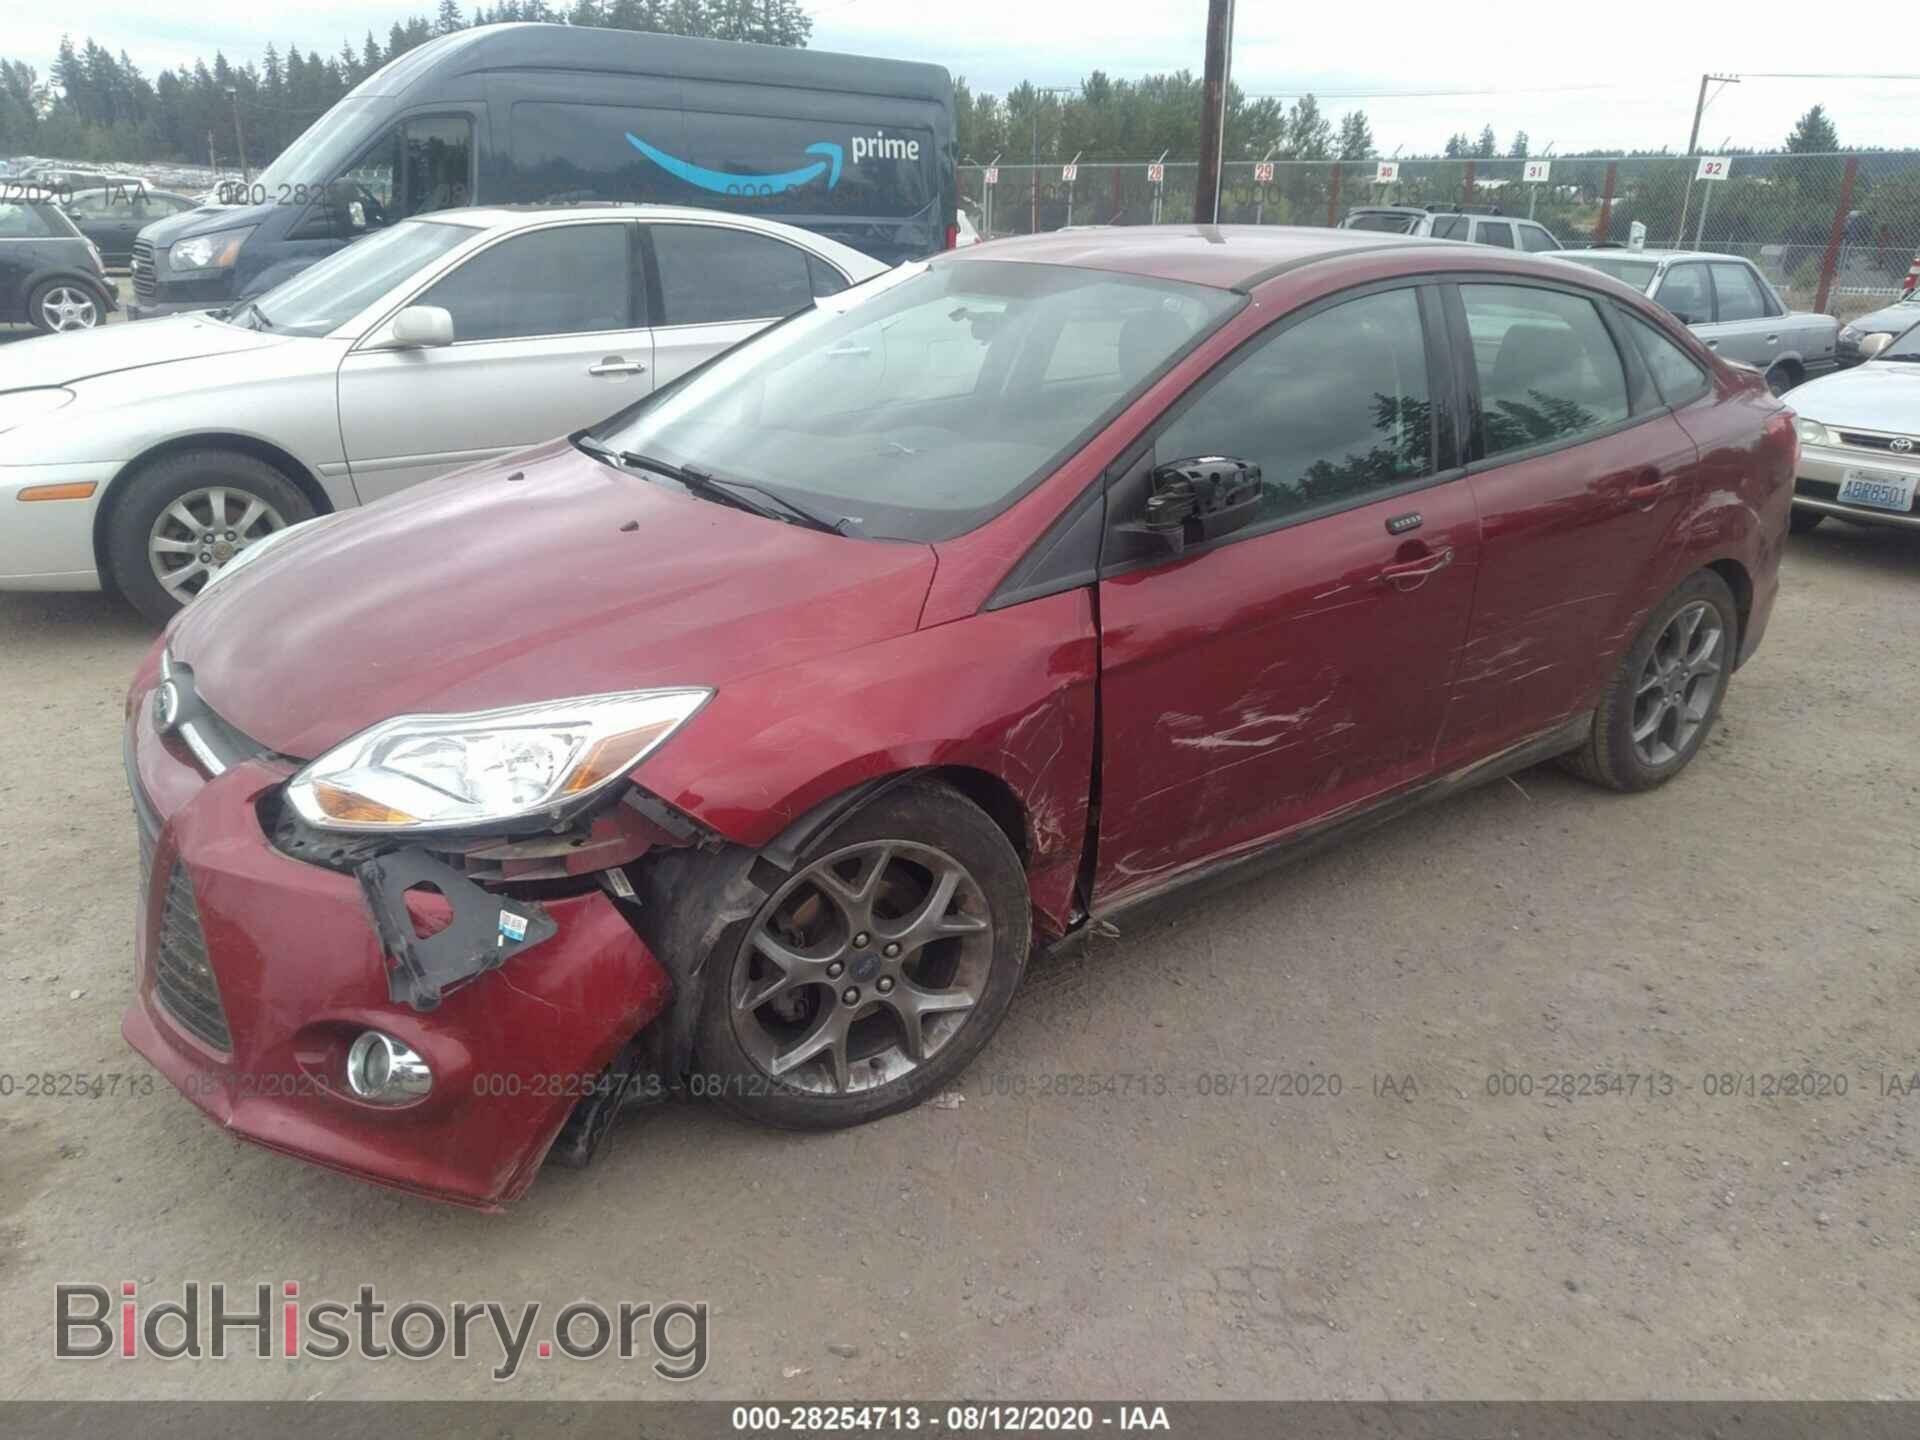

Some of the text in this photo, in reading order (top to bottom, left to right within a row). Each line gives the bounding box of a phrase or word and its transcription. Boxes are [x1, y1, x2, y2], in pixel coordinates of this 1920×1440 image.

[852, 131, 919, 164] prime
[1064, 167, 1076, 179] 27
[1149, 165, 1163, 180] 28
[1255, 165, 1272, 180] 29
[1529, 166, 1543, 178] 31
[1704, 162, 1723, 175] 32
[1843, 480, 1907, 505] ABR8501
